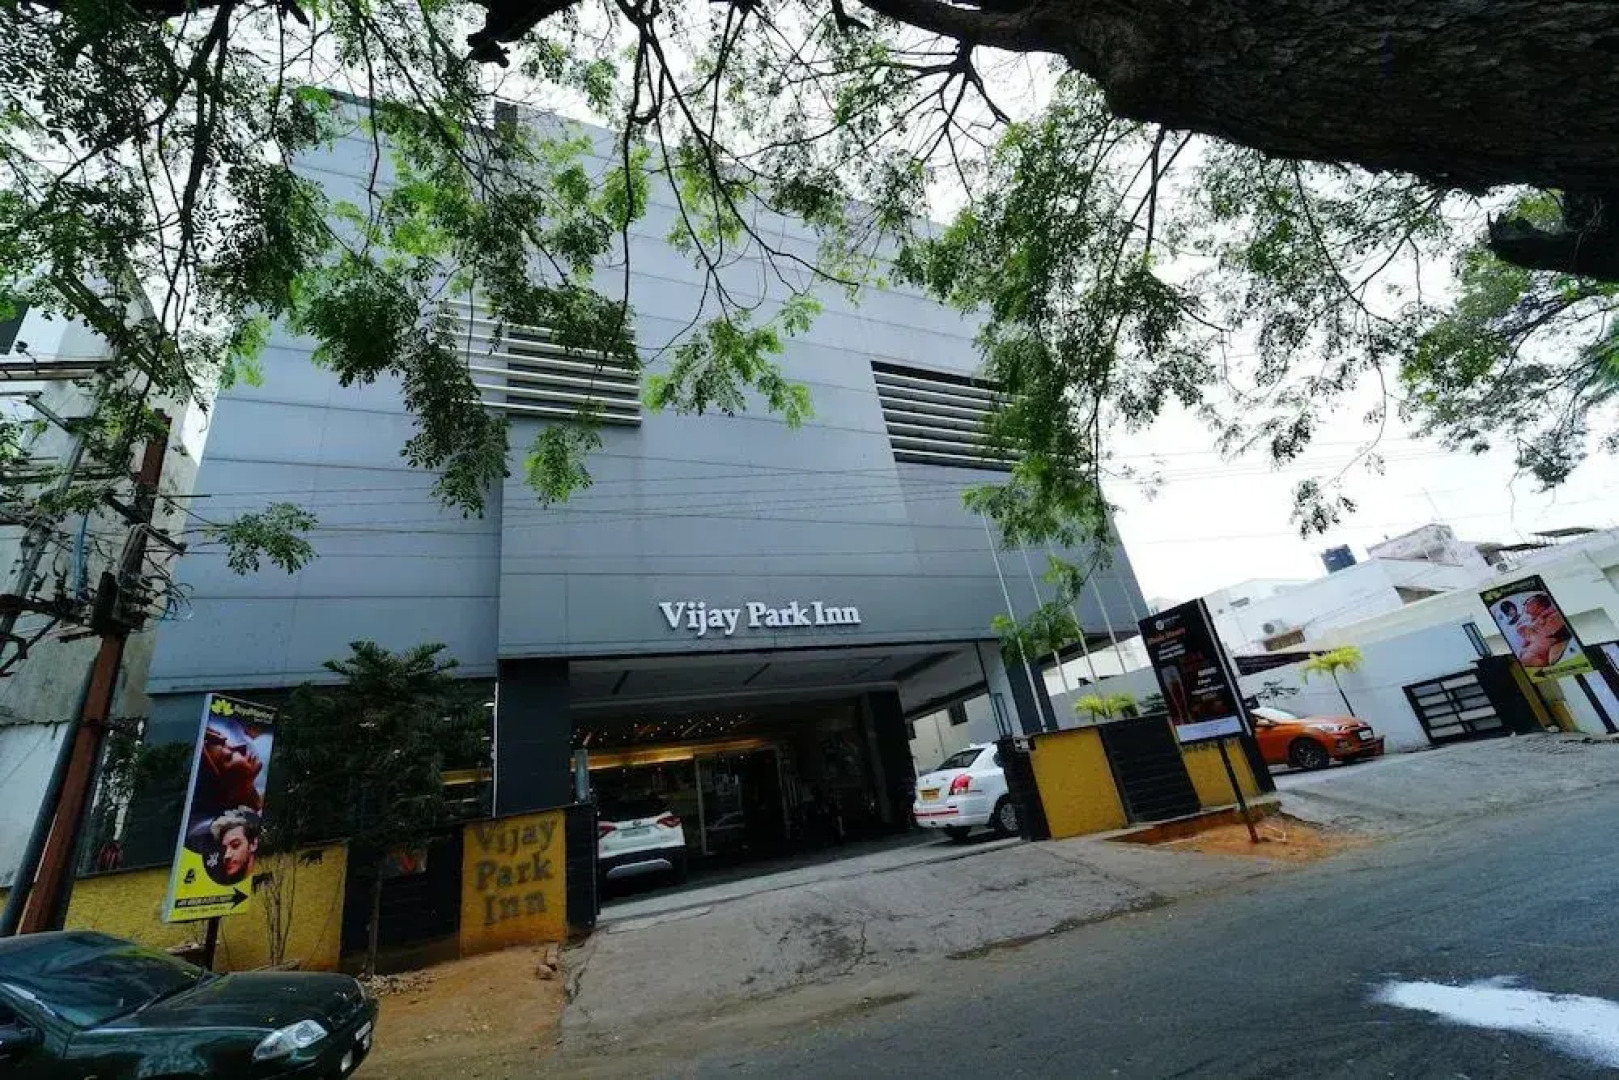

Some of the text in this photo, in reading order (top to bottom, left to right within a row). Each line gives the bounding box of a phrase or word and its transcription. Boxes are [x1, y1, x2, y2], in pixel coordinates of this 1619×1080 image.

[659, 601, 862, 636] Vijay Park Inn
[475, 817, 558, 855] Vijay
[476, 851, 554, 890] Park
[484, 892, 547, 926] Inn
